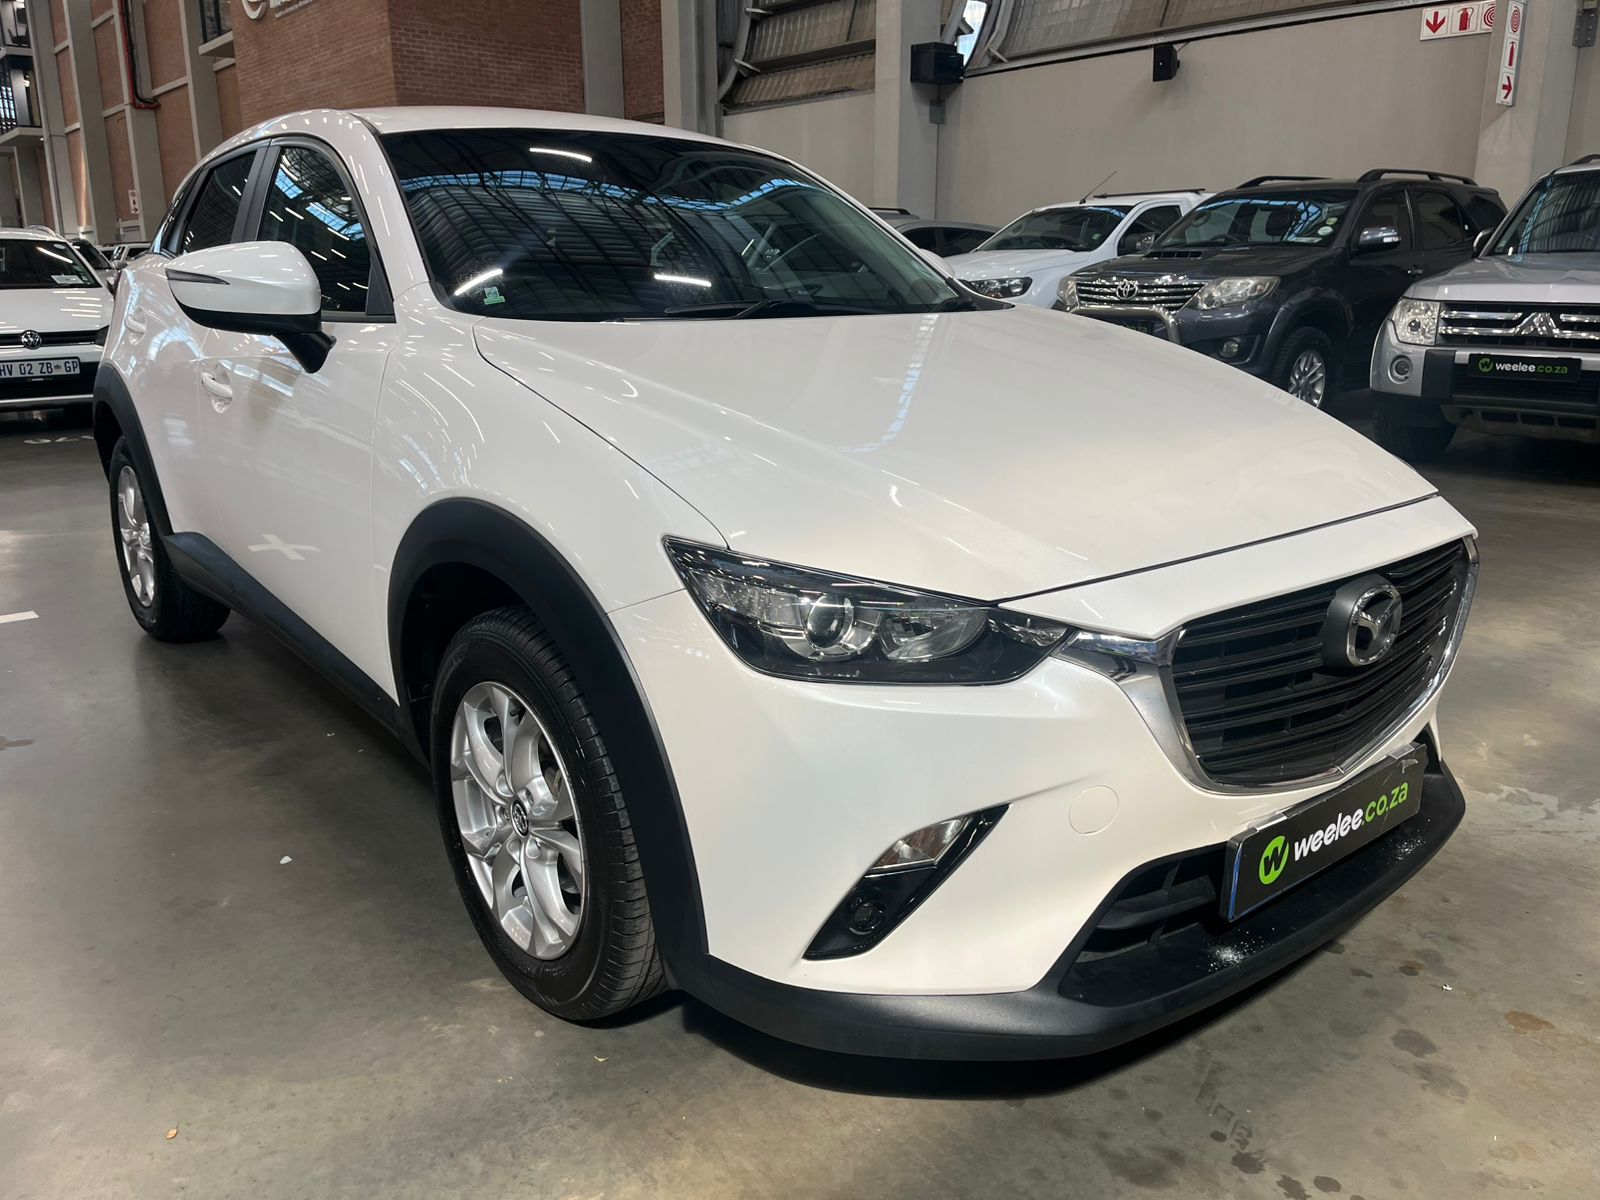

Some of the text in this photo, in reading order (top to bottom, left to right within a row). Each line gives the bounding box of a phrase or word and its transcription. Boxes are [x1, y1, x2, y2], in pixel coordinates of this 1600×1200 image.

[0, 360, 79, 376] HV 02 ZB GP
[1495, 362, 1568, 374] weelee.co.za
[1294, 782, 1409, 861] weelee.co.za
